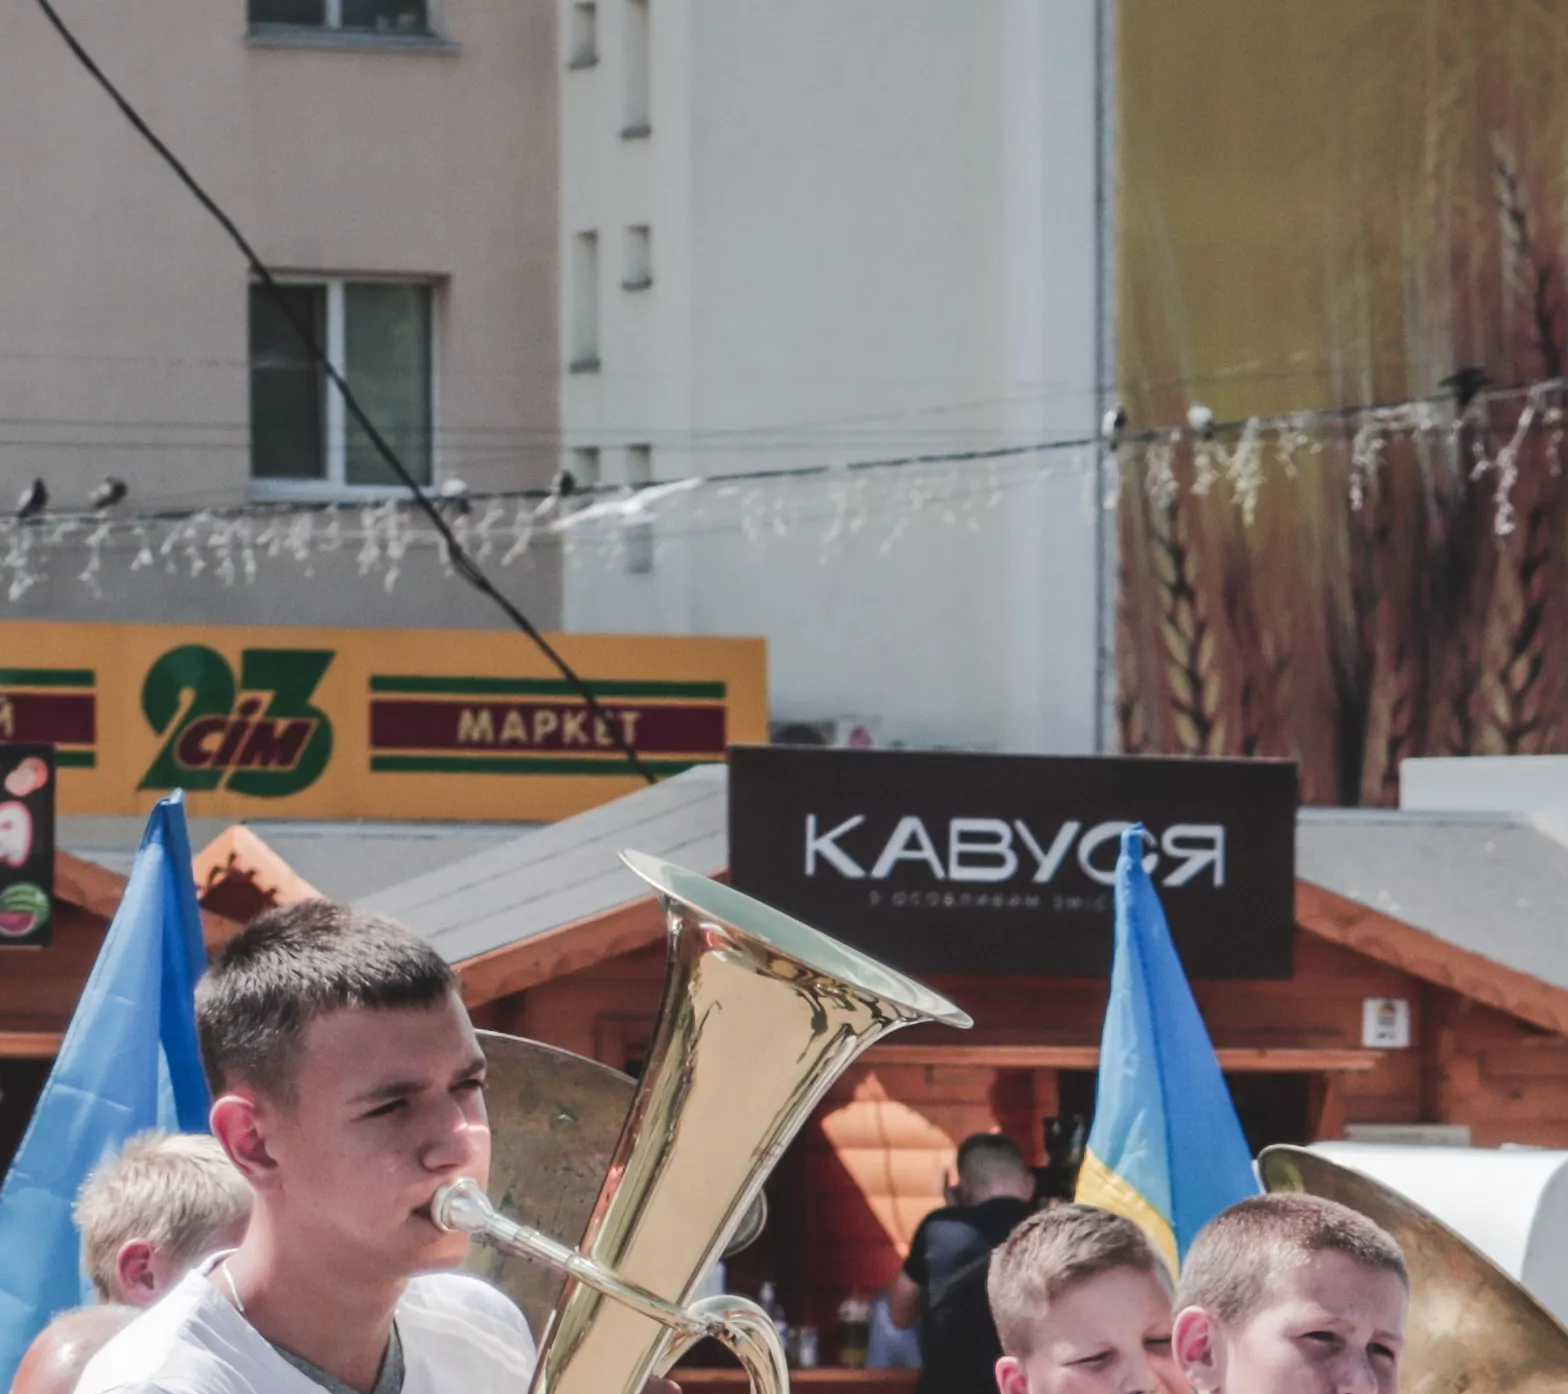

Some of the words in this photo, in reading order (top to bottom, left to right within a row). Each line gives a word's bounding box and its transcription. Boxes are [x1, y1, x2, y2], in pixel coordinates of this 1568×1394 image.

[135, 643, 337, 798] 23
[456, 707, 641, 745] МАРКЕТ
[804, 813, 1225, 888] КАВУСЯ
